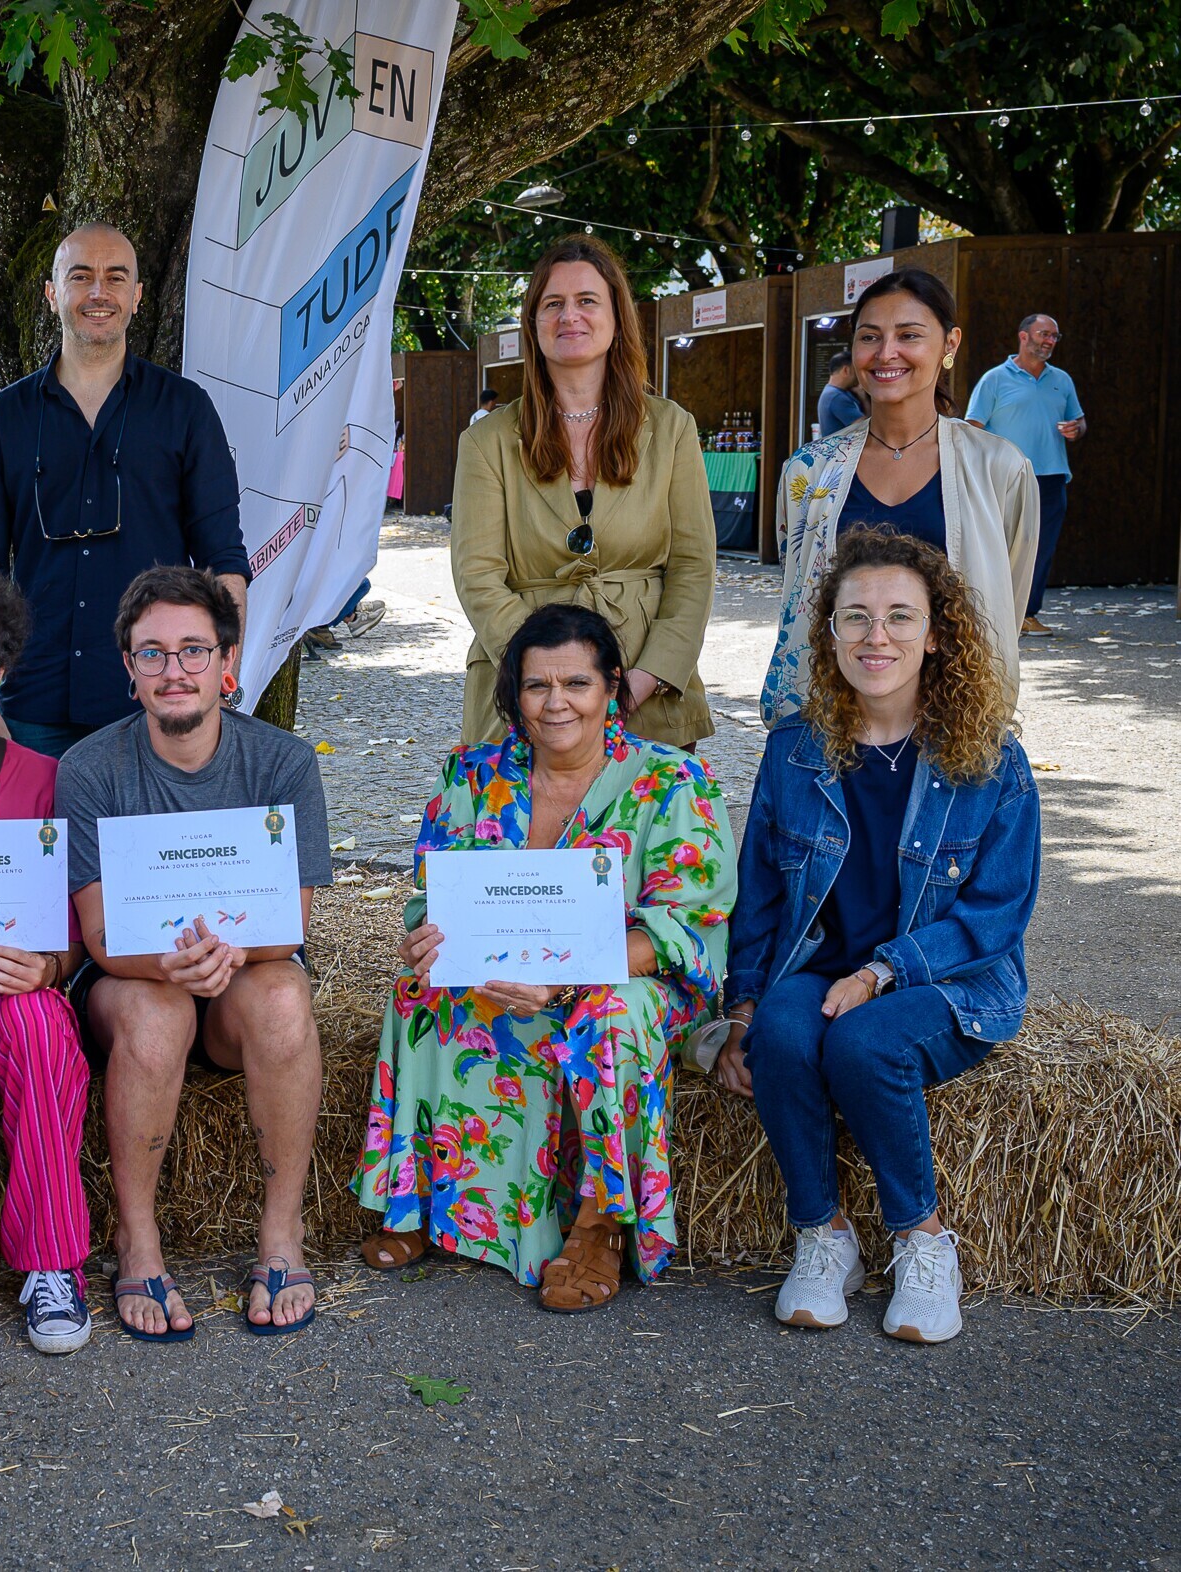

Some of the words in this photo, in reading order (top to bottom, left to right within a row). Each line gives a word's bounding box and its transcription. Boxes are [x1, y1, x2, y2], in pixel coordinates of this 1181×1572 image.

[368, 58, 416, 122] EN
[292, 360, 332, 406] VIANA
[334, 337, 350, 365] DO
[251, 513, 300, 574] ABINETE
[159, 846, 237, 861] VENCEDORES
[234, 887, 278, 895] INVENTADAS
[485, 886, 563, 896] VENCEDORES
